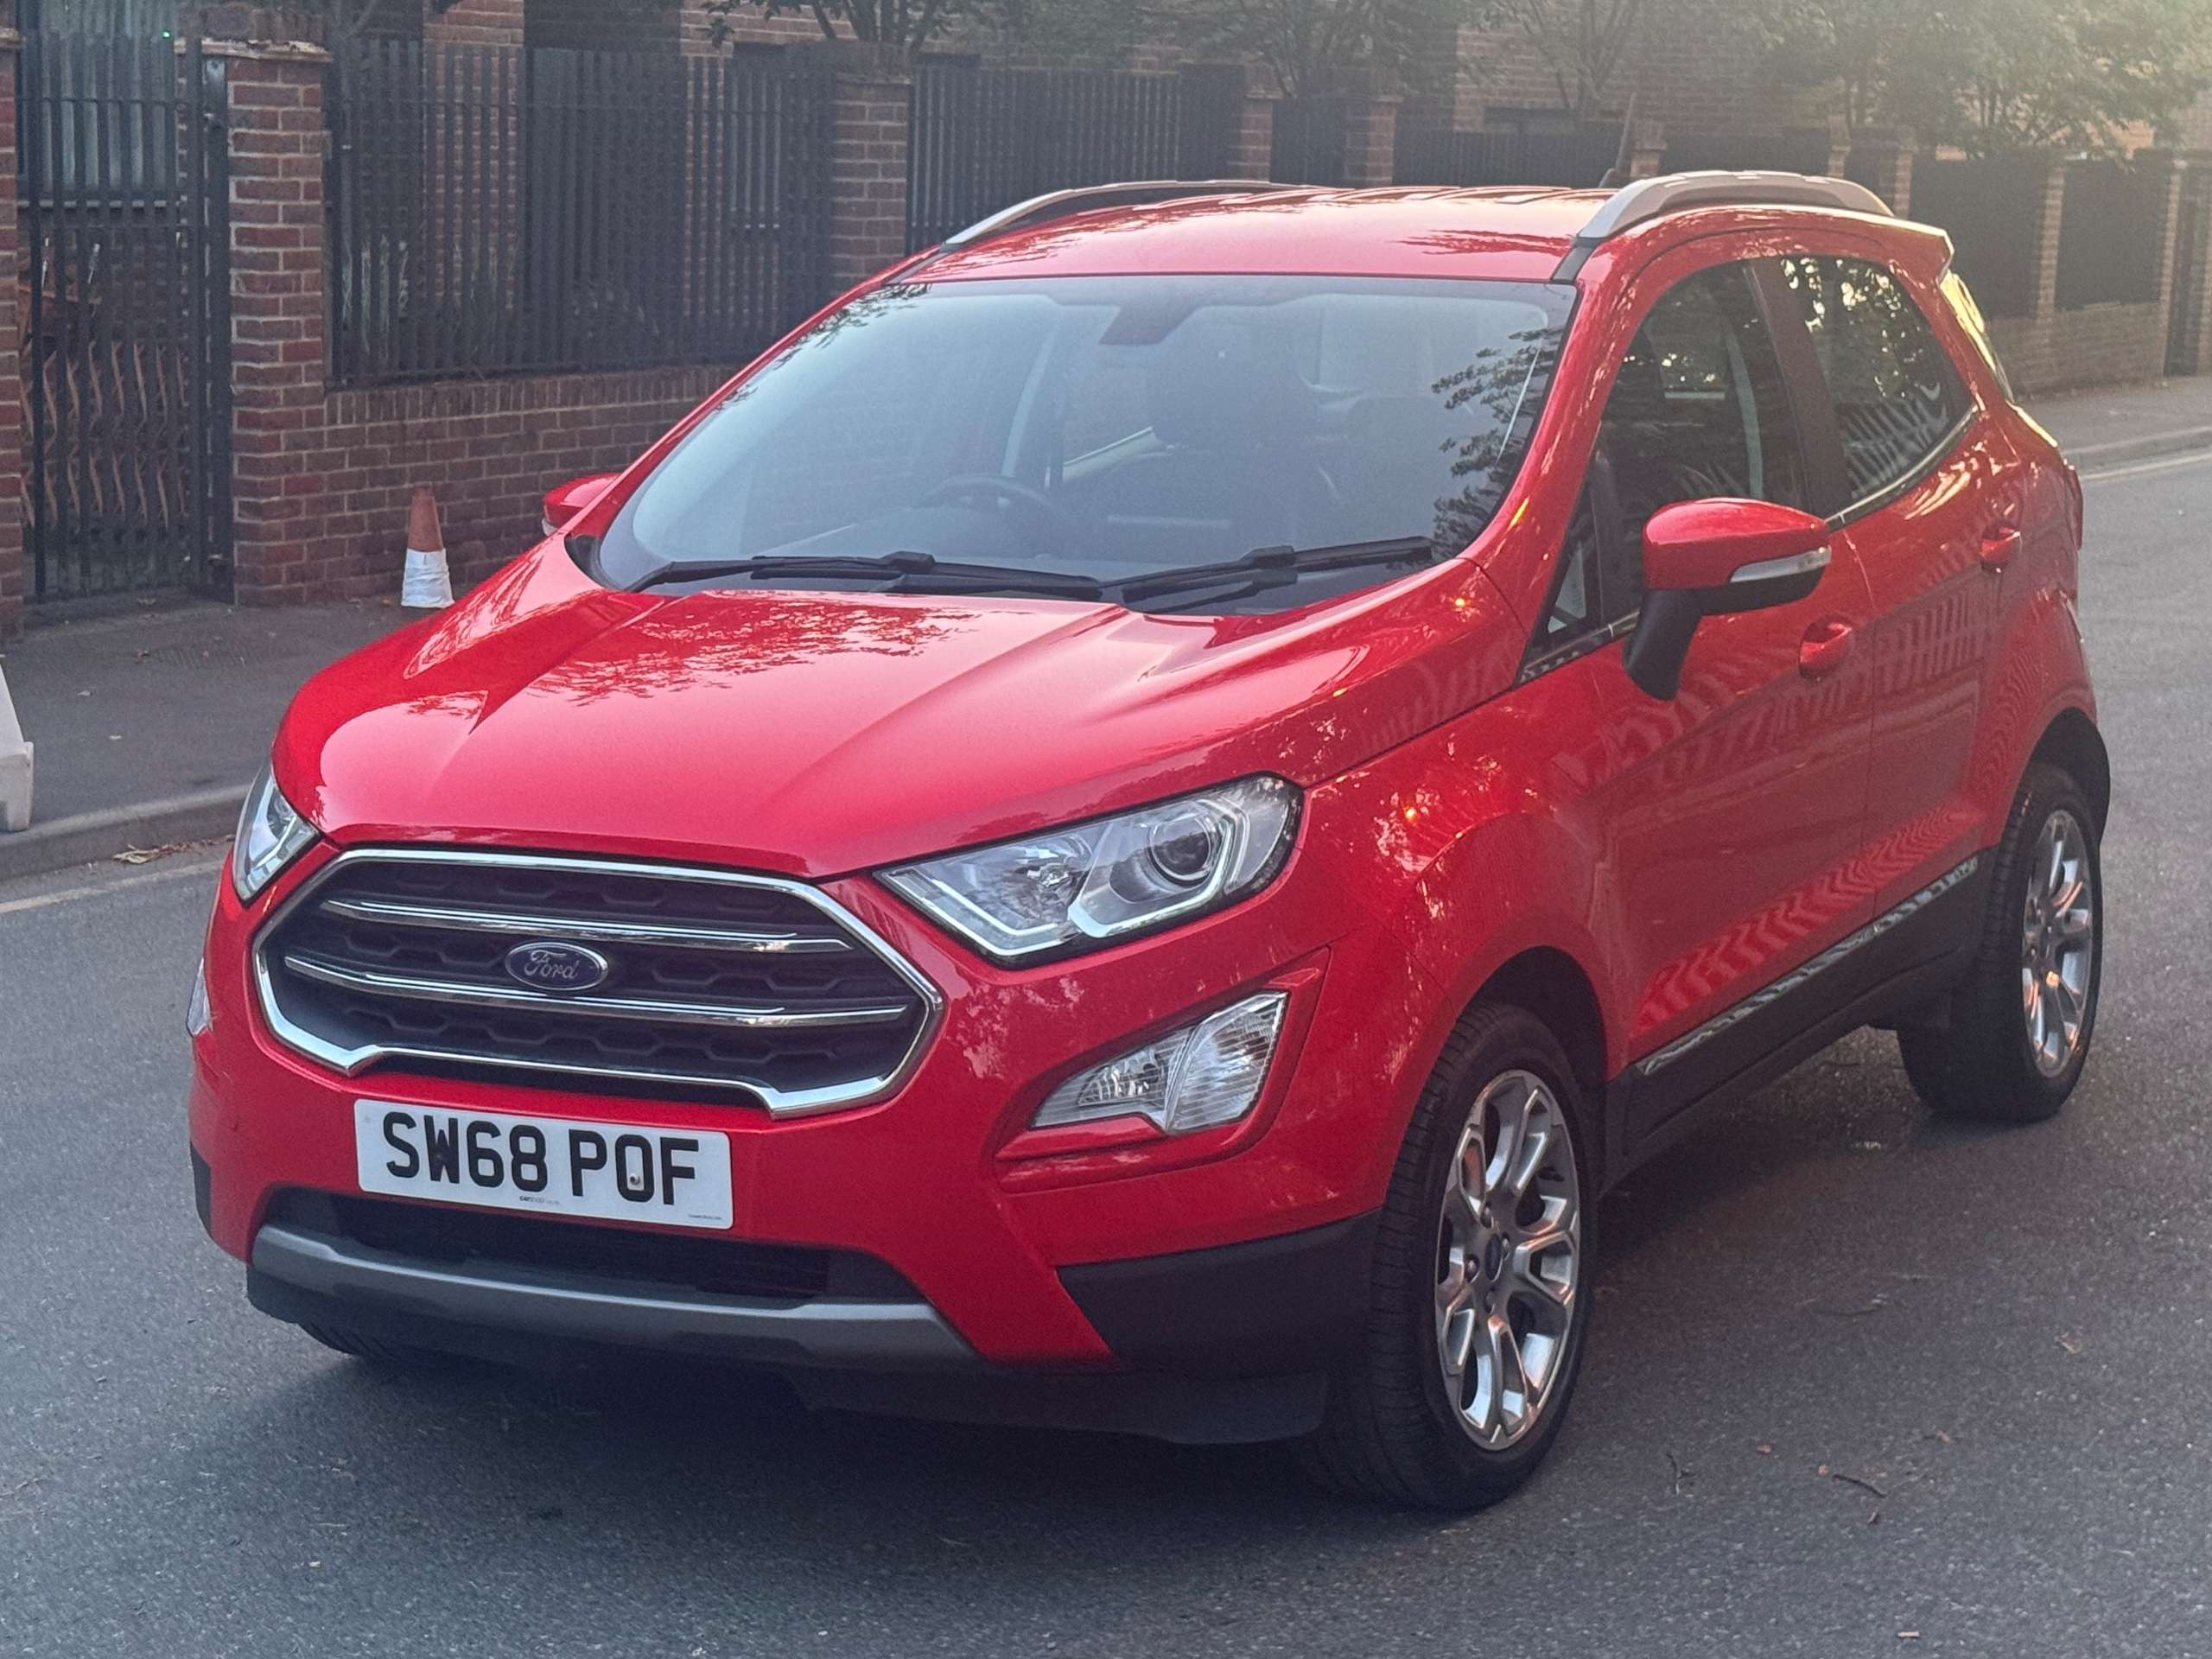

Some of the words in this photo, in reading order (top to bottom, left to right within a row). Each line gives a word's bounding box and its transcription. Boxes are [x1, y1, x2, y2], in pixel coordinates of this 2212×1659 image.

[524, 950, 580, 979] Ford
[383, 1111, 548, 1192] SW68
[569, 1128, 699, 1205] POF
